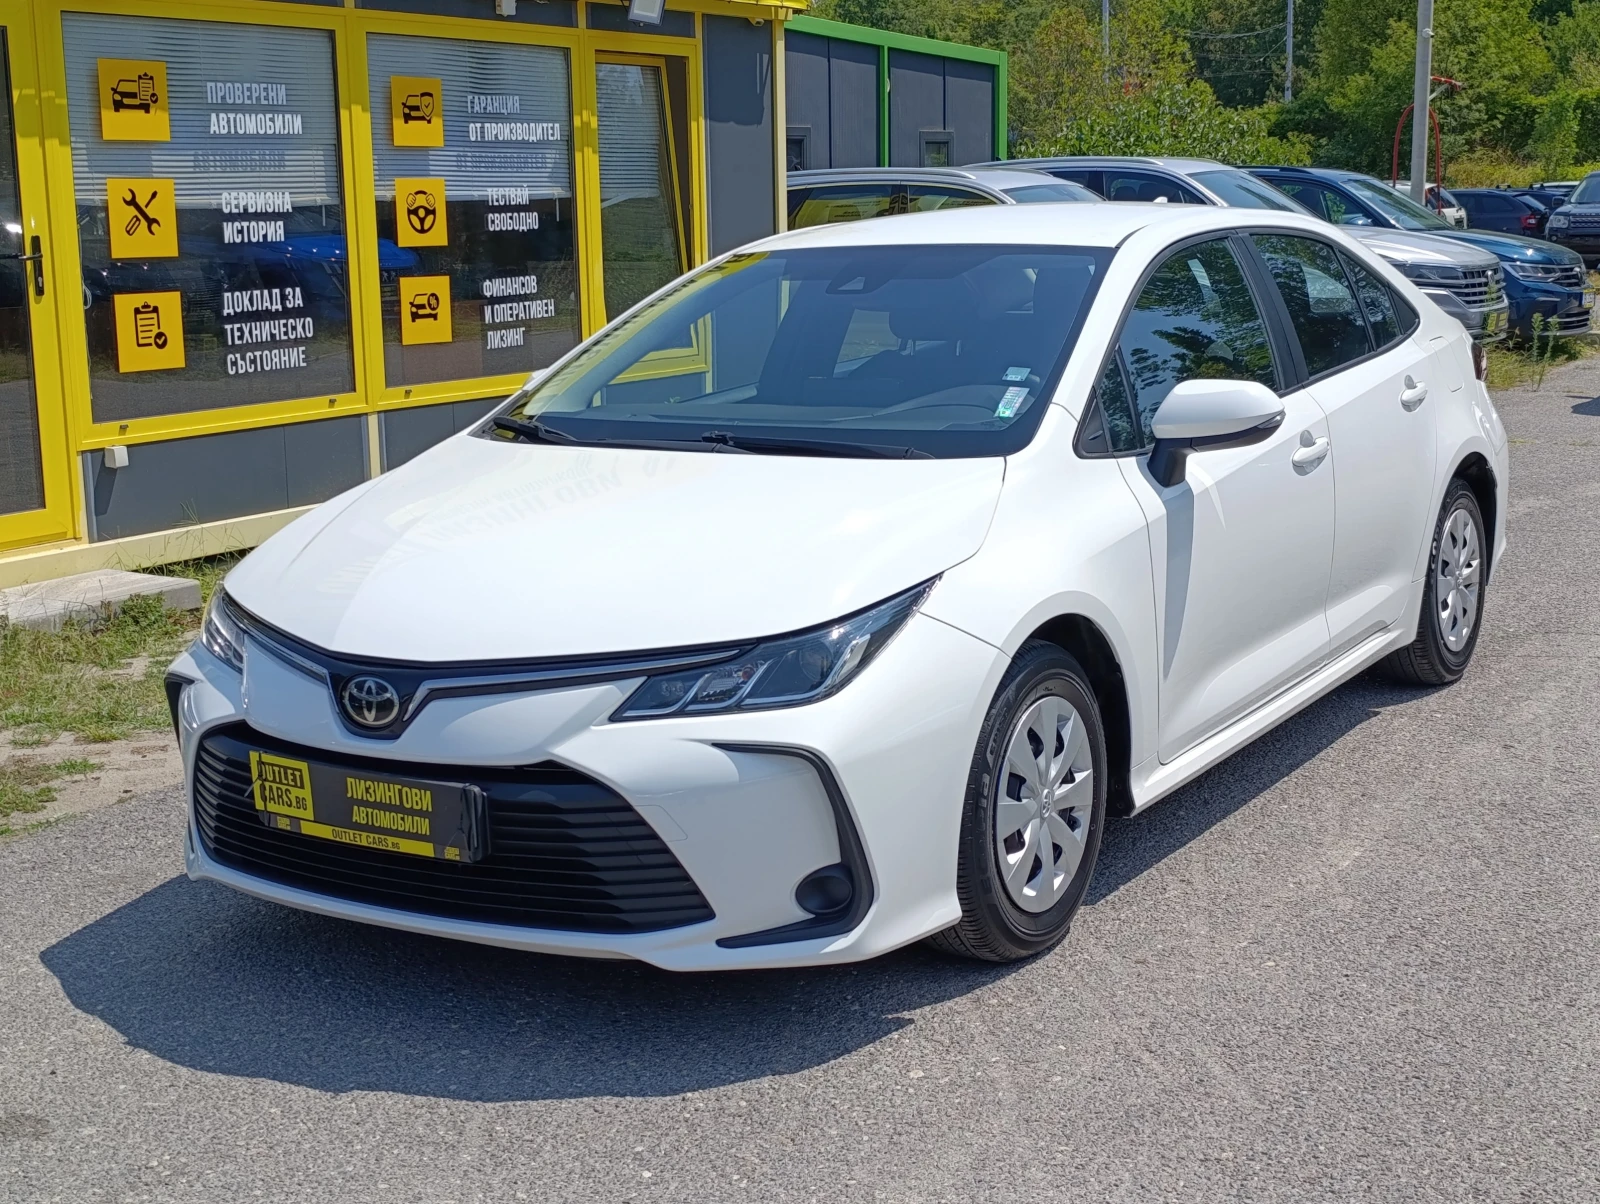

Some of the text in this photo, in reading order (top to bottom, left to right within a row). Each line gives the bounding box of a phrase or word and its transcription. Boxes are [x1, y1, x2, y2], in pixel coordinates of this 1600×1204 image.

[207, 82, 287, 105] ПРОВЕРЕНИ
[467, 95, 520, 115] ГАРАНЦИЯ
[210, 113, 303, 135] АВТОМОБИЛИ
[469, 123, 560, 142] ОТ ПРОИЗВОДИТЕЛ
[222, 192, 292, 213] СЕРВИЗНА
[487, 184, 529, 205] ТЕСТВАЙ
[223, 221, 285, 244] ИСТОРИЯ
[488, 212, 539, 232] СВОБОДНО
[483, 275, 538, 298] ФИНАНСОВ
[223, 287, 304, 316] ДОКЛАД ЗА
[484, 299, 555, 324] И ОПЕРАТИВЕН
[225, 317, 313, 345] ТЕХНИЧЕСКО
[487, 327, 526, 350] ЛИЗИНГ
[227, 346, 307, 375] СЪСТОЯНИЕ
[259, 763, 301, 787] OUTLET
[346, 777, 433, 812] ЛИЗИНГОВИ
[352, 805, 430, 836] АВТОМОБИЛИ
[331, 828, 401, 850] OUTLET CARS.BG
